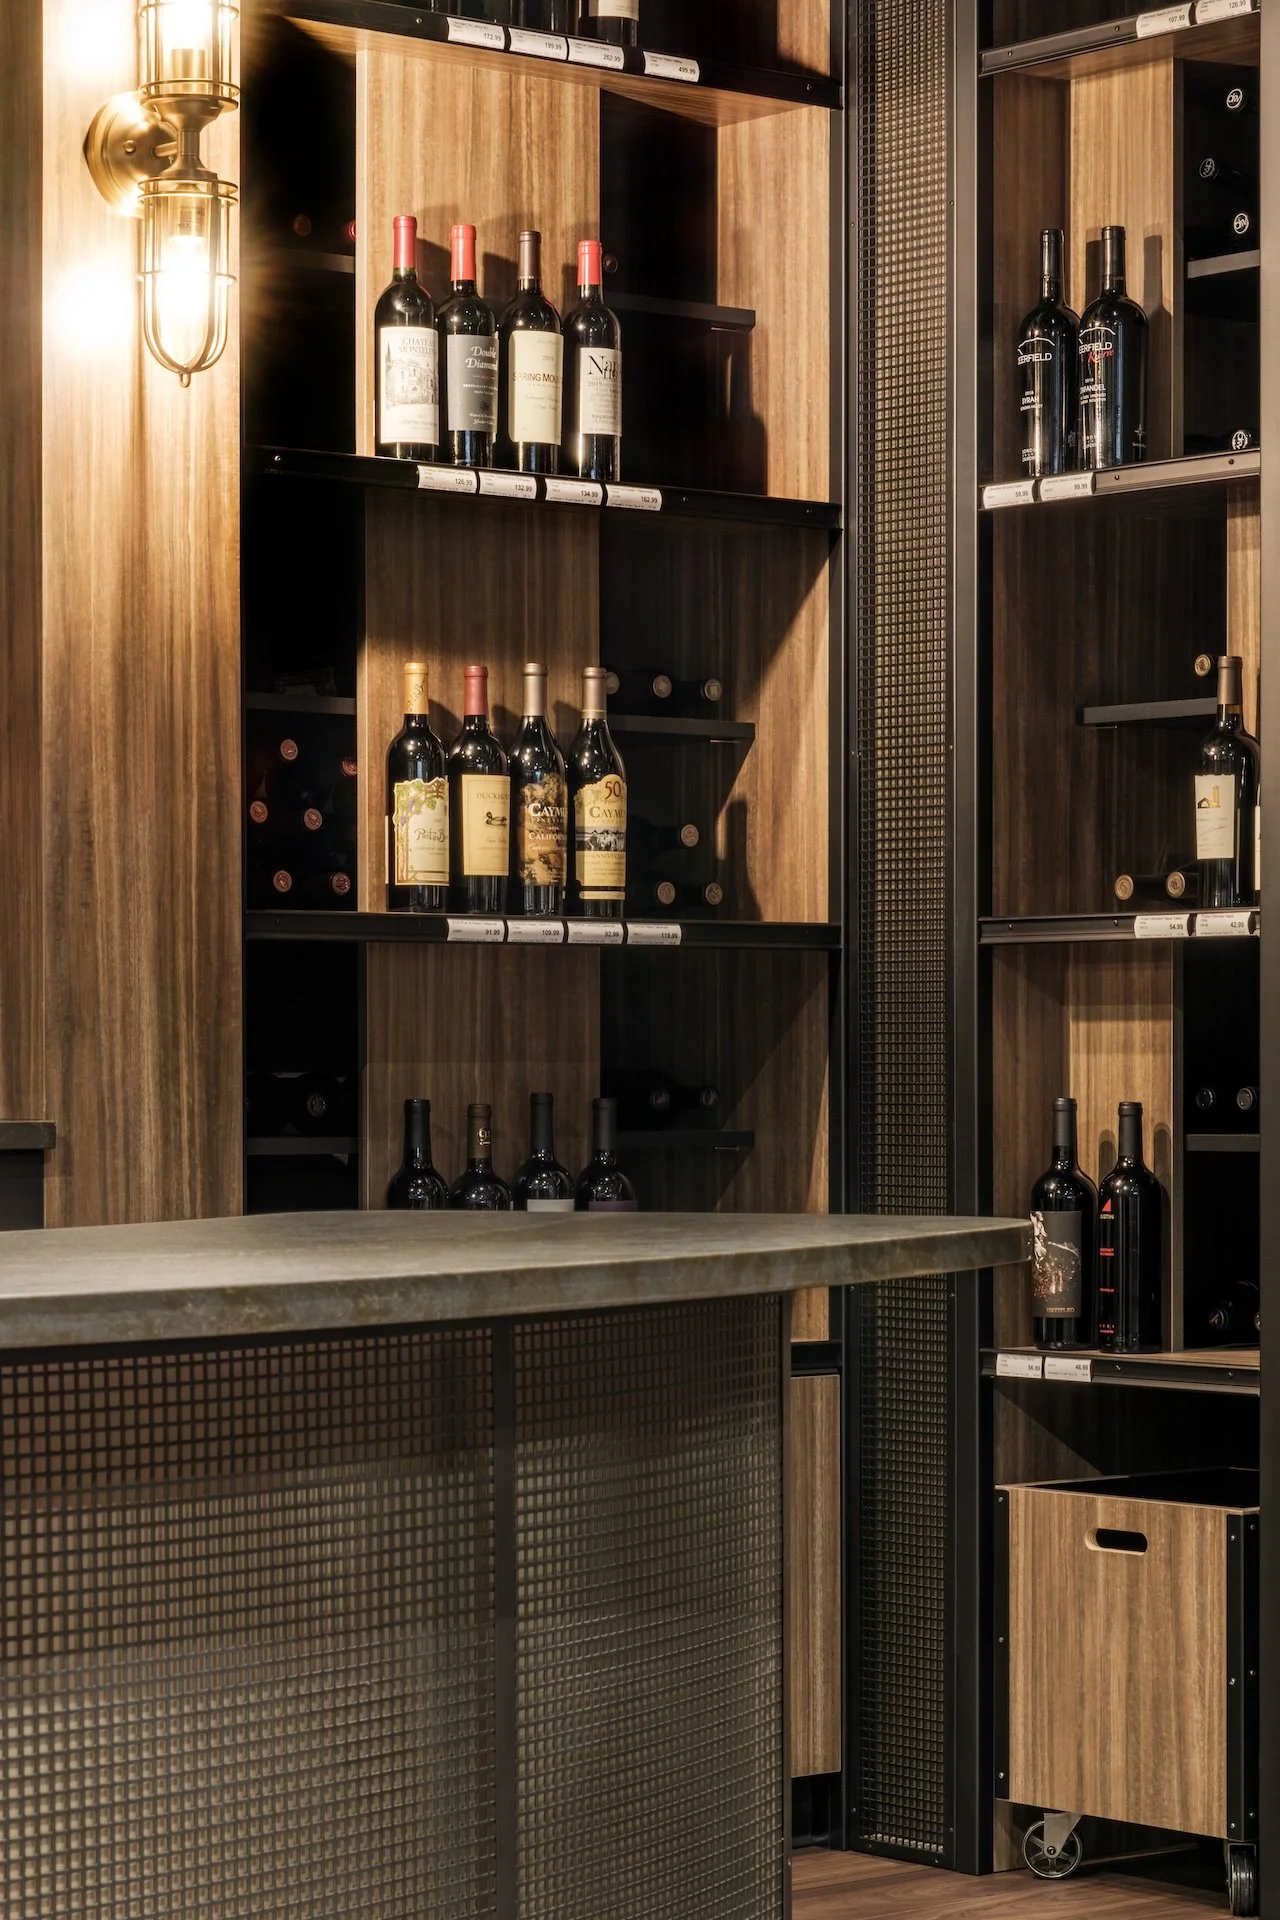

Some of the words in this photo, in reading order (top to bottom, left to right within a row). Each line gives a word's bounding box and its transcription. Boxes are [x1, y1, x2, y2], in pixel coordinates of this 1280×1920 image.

[470, 346, 496, 358] Double
[512, 372, 541, 382] SPRING
[542, 373, 561, 384] MOU
[604, 781, 622, 799] 50
[1169, 923, 1184, 931] 54.99
[1230, 921, 1245, 929] 42.99
